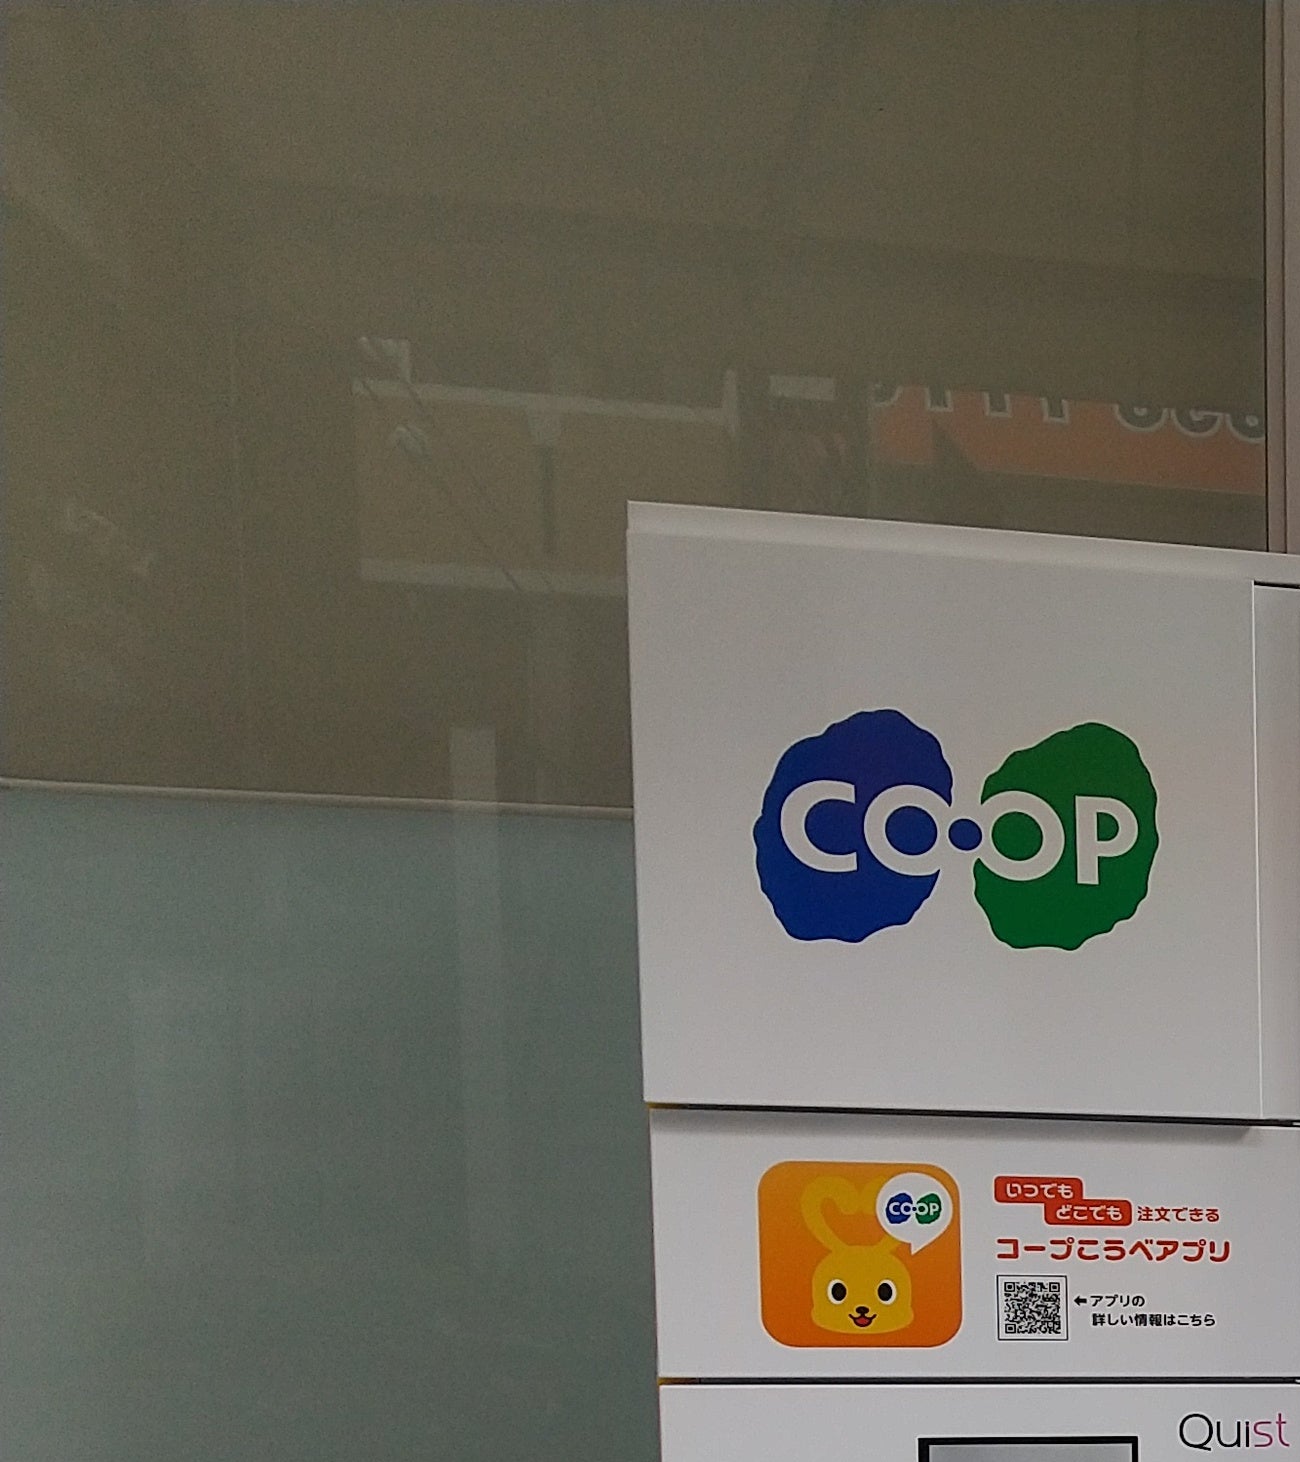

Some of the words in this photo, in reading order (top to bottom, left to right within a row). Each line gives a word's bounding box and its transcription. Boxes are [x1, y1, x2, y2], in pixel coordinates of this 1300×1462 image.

[1005, 1182, 1074, 1199] いつでも
[1055, 1204, 1123, 1223] どこでも
[1136, 1206, 1220, 1224] 注文できる
[996, 1237, 1231, 1263] コープこうべアプリ
[1090, 1293, 1146, 1309] アプリの
[1091, 1312, 1216, 1328] 詳しい情報はこちら
[1178, 1412, 1291, 1452] Quist
